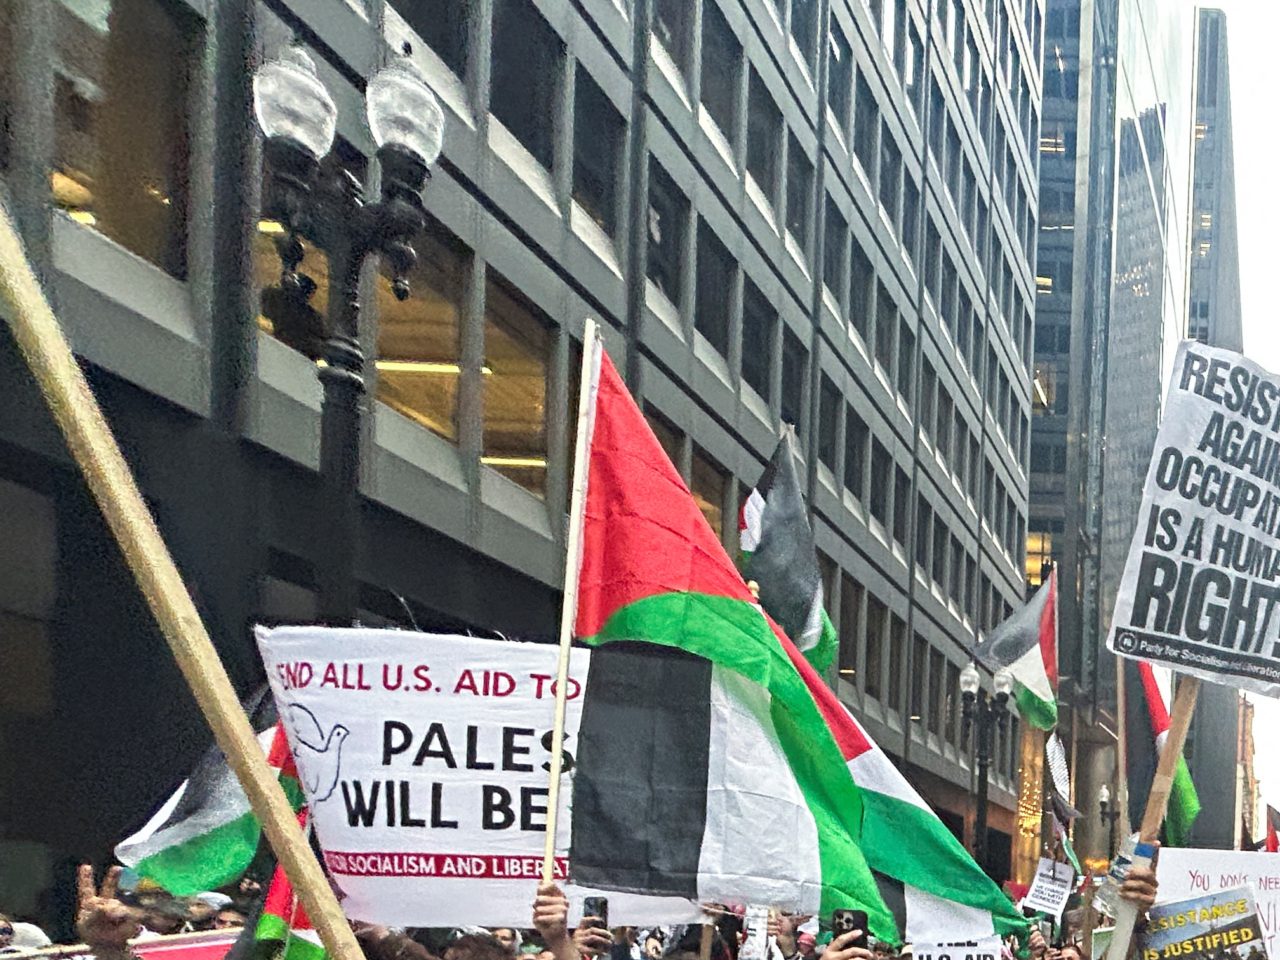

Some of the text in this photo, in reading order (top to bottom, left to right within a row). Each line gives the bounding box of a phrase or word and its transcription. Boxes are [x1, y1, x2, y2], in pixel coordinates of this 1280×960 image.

[1144, 505, 1182, 552] IS
[1182, 517, 1204, 561] A
[320, 662, 371, 690] ALL
[382, 664, 441, 692] U.S.
[454, 669, 516, 697] AID
[530, 673, 582, 700] TO
[382, 720, 575, 773] PALES
[341, 780, 550, 832] WILL BE
[347, 855, 436, 875] SOCIALISM
[441, 857, 486, 876] AND
[1189, 870, 1210, 891] YOU
[1151, 898, 1248, 932] ESISTANCE
[1164, 928, 1254, 958] JUSTIFIED
